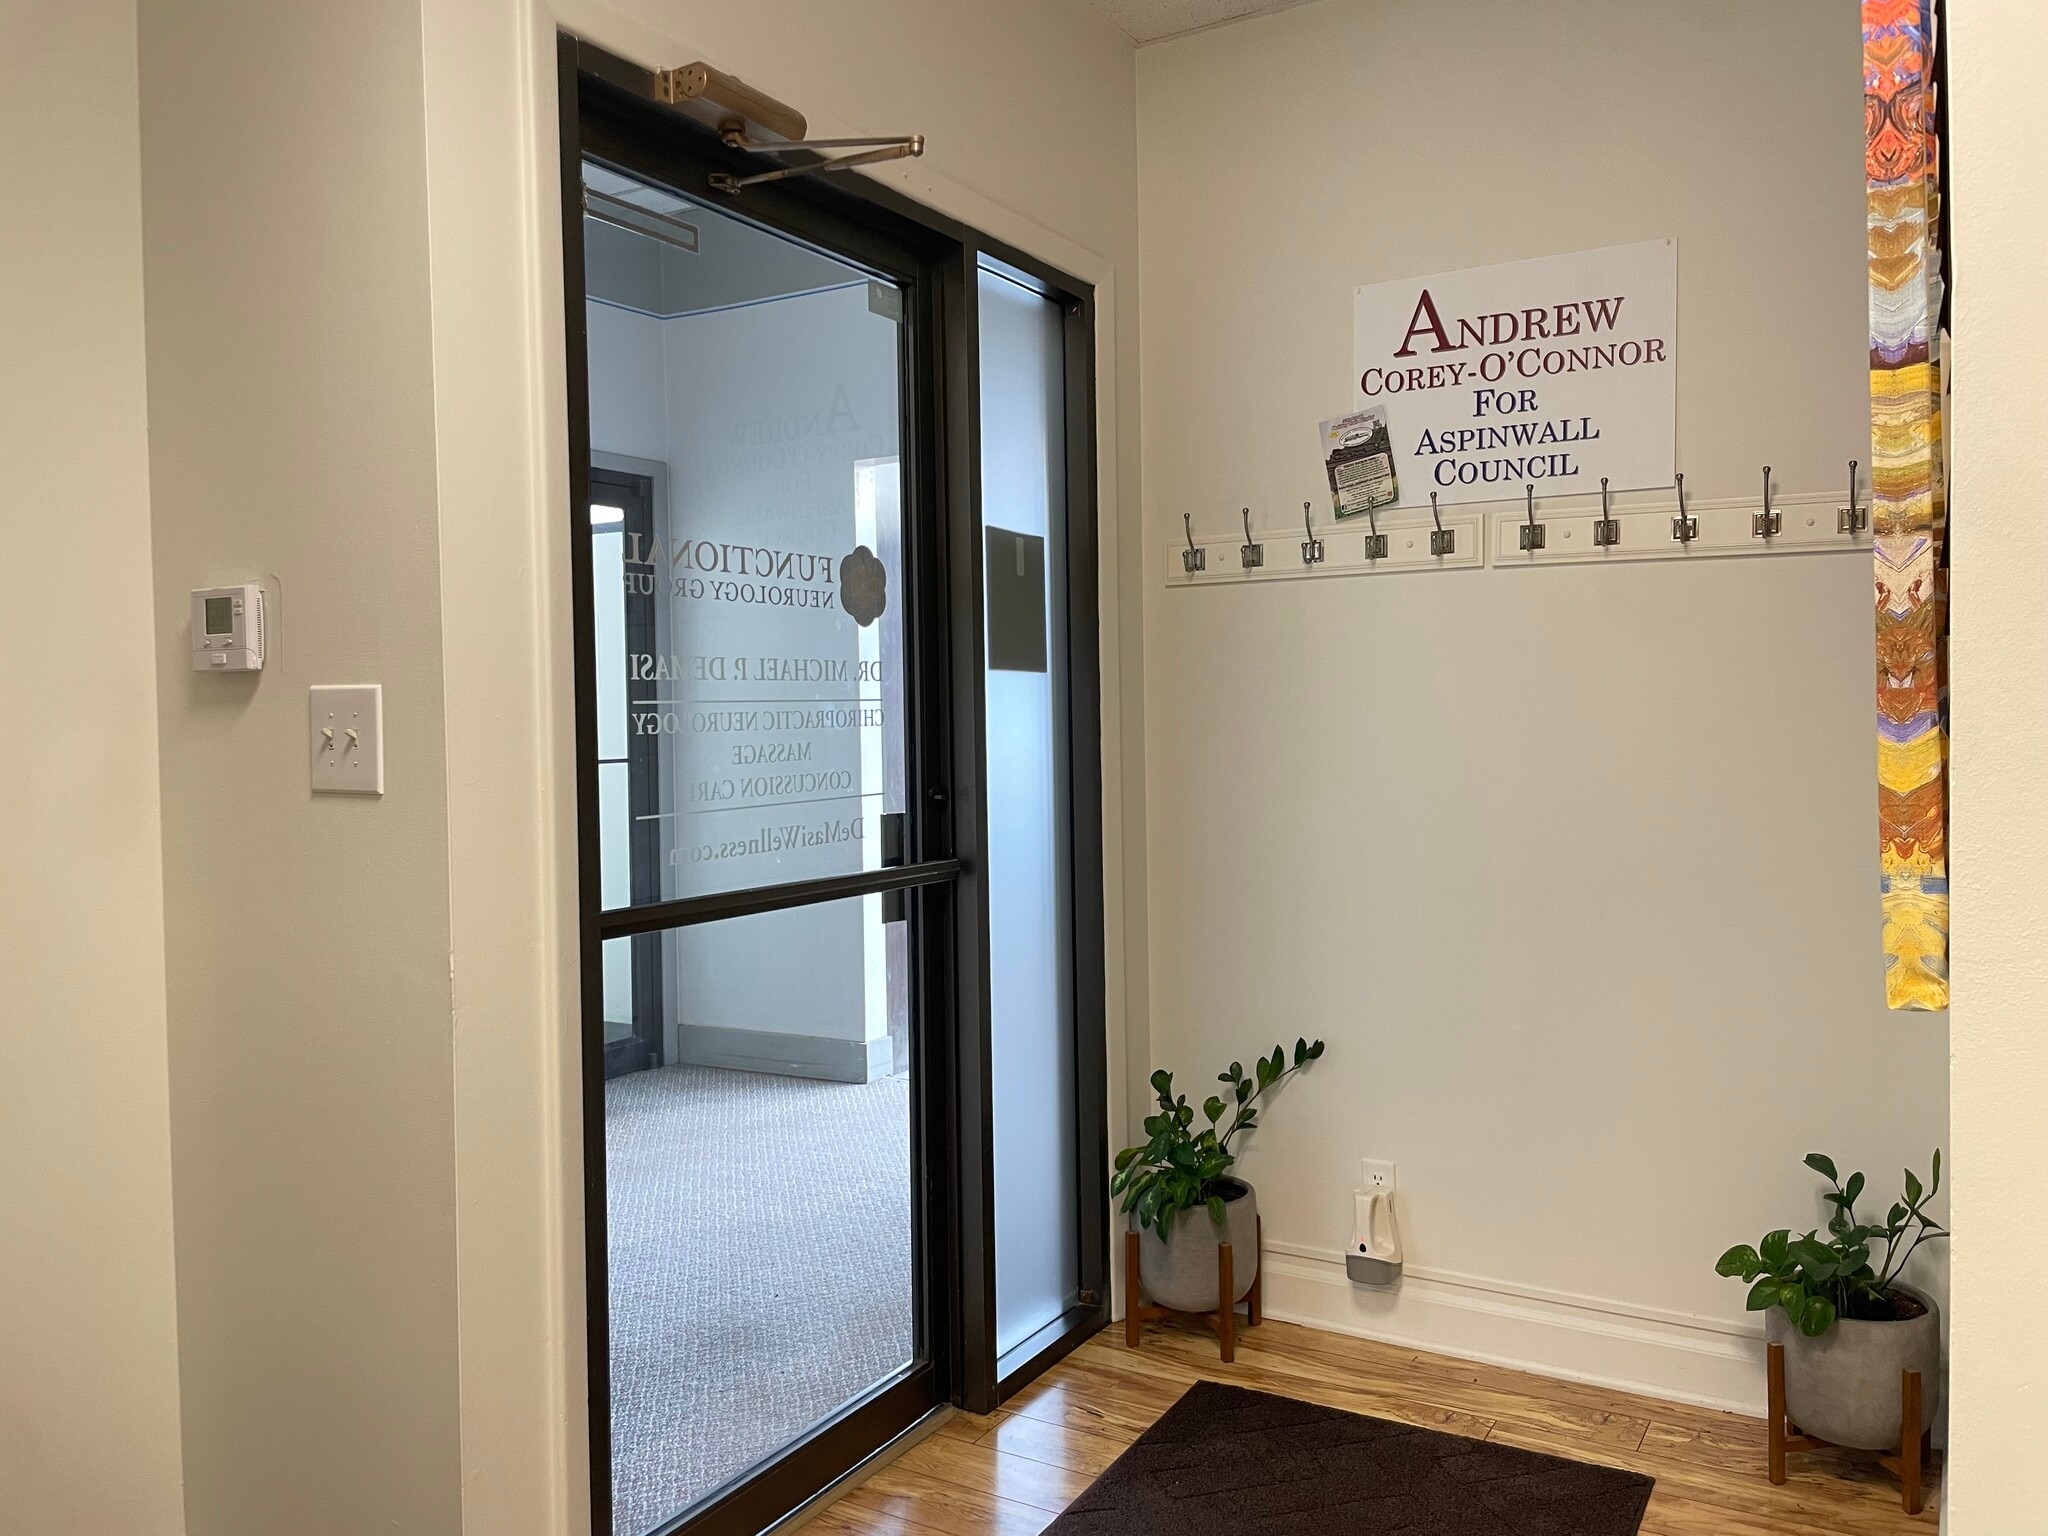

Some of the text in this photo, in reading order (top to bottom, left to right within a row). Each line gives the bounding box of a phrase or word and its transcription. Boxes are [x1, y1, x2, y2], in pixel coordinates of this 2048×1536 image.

[1393, 289, 1626, 358] ANDREW
[1361, 338, 1666, 396] COREY-O'CONNOR
[1472, 389, 1538, 417] FOR
[1413, 417, 1600, 456] ASPINWALL
[1433, 453, 1579, 486] COUNCIL
